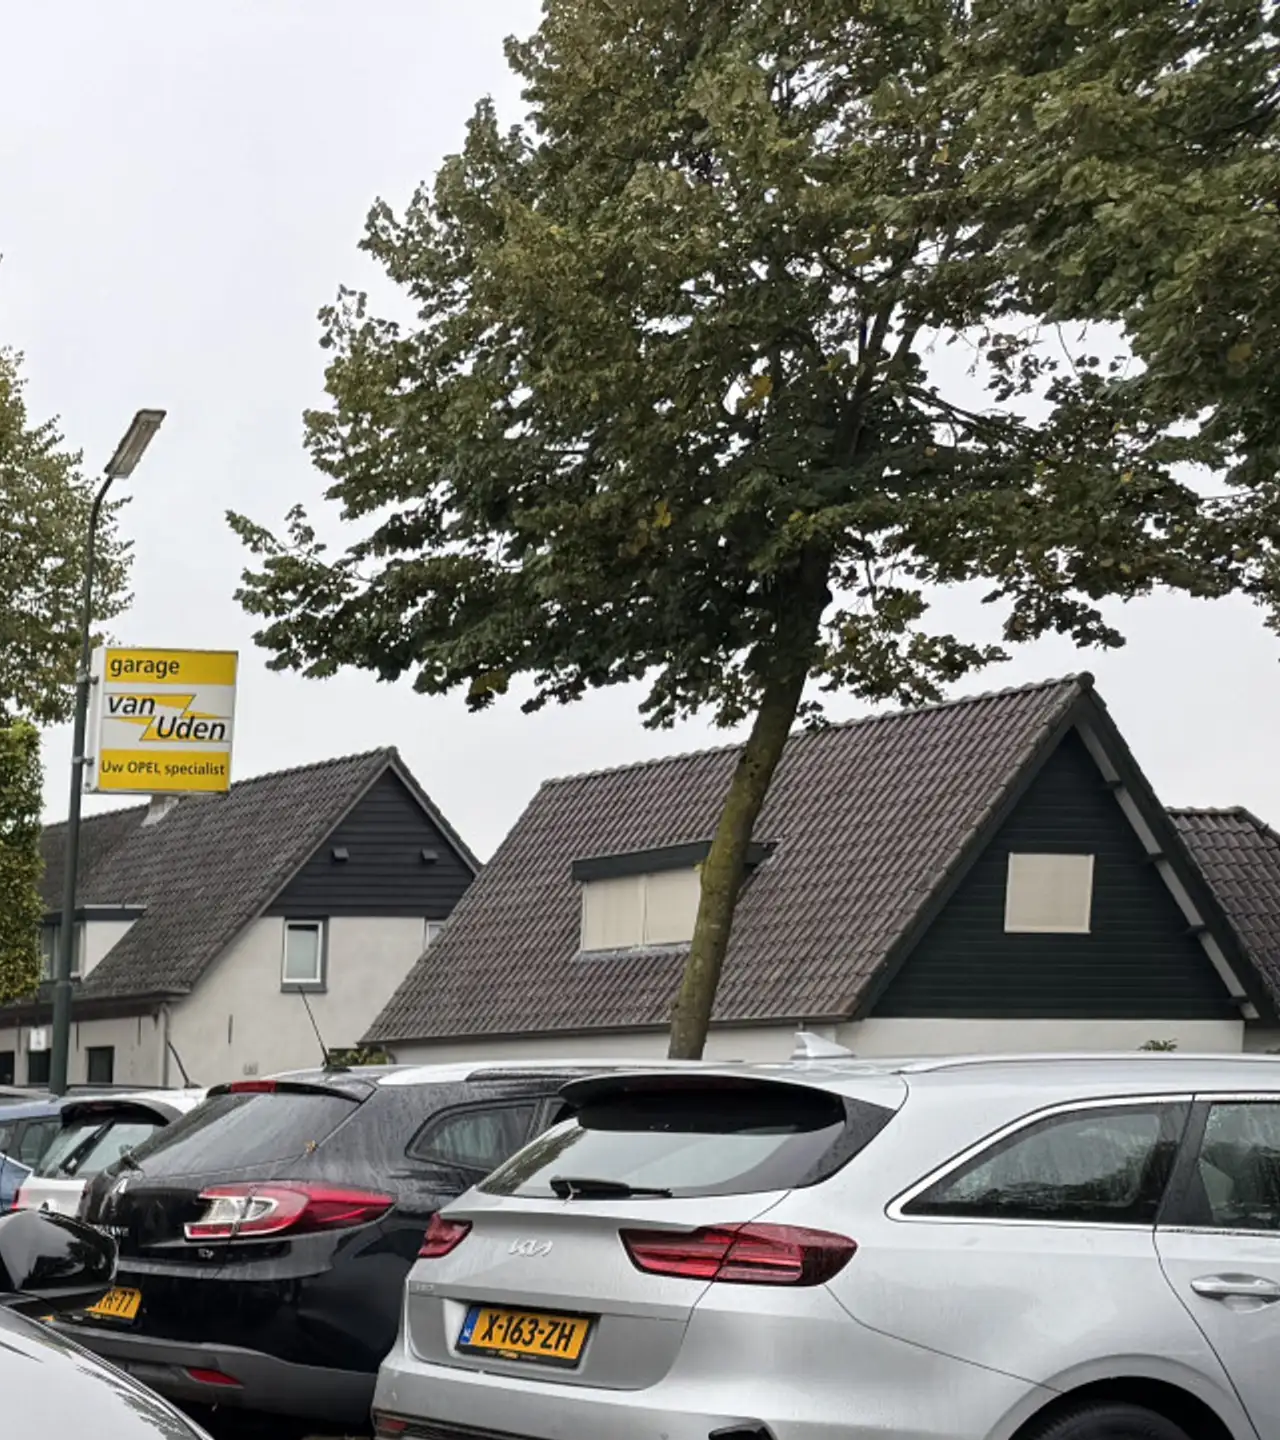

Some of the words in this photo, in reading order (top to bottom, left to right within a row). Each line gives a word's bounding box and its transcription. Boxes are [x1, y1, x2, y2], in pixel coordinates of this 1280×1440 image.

[110, 658, 180, 679] garage
[108, 695, 156, 715] van
[157, 715, 226, 740] Uden
[101, 760, 124, 773] Uw
[128, 761, 161, 774] OPEL
[165, 762, 225, 776] specialist
[480, 1313, 577, 1352] X-163-ZH
